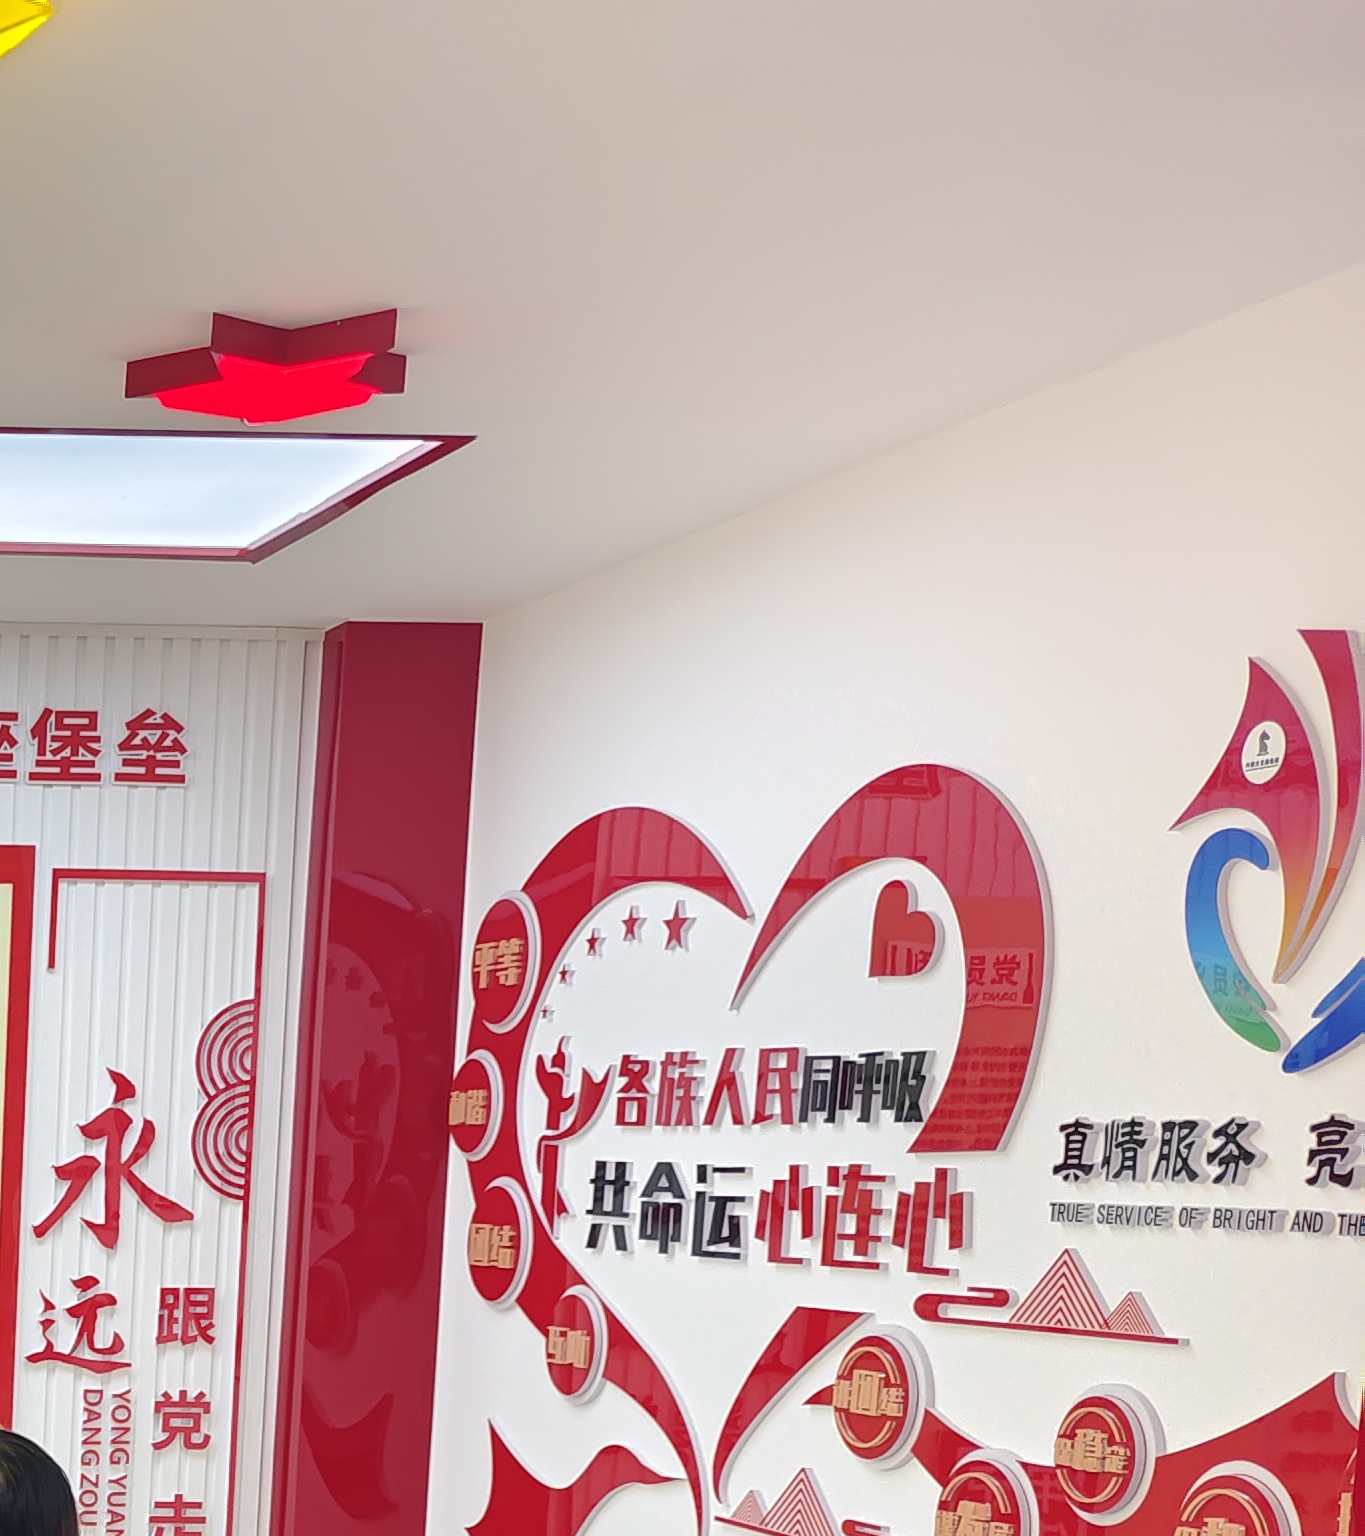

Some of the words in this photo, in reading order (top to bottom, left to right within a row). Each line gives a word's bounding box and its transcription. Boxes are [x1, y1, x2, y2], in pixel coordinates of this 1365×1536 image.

[473, 937, 524, 989] 平等
[614, 1047, 928, 1127] 各族人民同呼吸
[1052, 1118, 1257, 1185] 真情服务
[1305, 1114, 1356, 1188] 亮
[469, 1223, 517, 1270] 团结
[585, 1160, 965, 1276] 共命运心连心
[1049, 1202, 1086, 1223] TRUE
[1096, 1205, 1165, 1227] SERVICE
[1178, 1207, 1199, 1228] OF
[1212, 1208, 1277, 1231] BRIGHT
[1290, 1210, 1324, 1233] AND
[81, 1387, 104, 1467] DANG
[109, 1387, 132, 1466] YONG
[78, 1473, 100, 1527] ZOU
